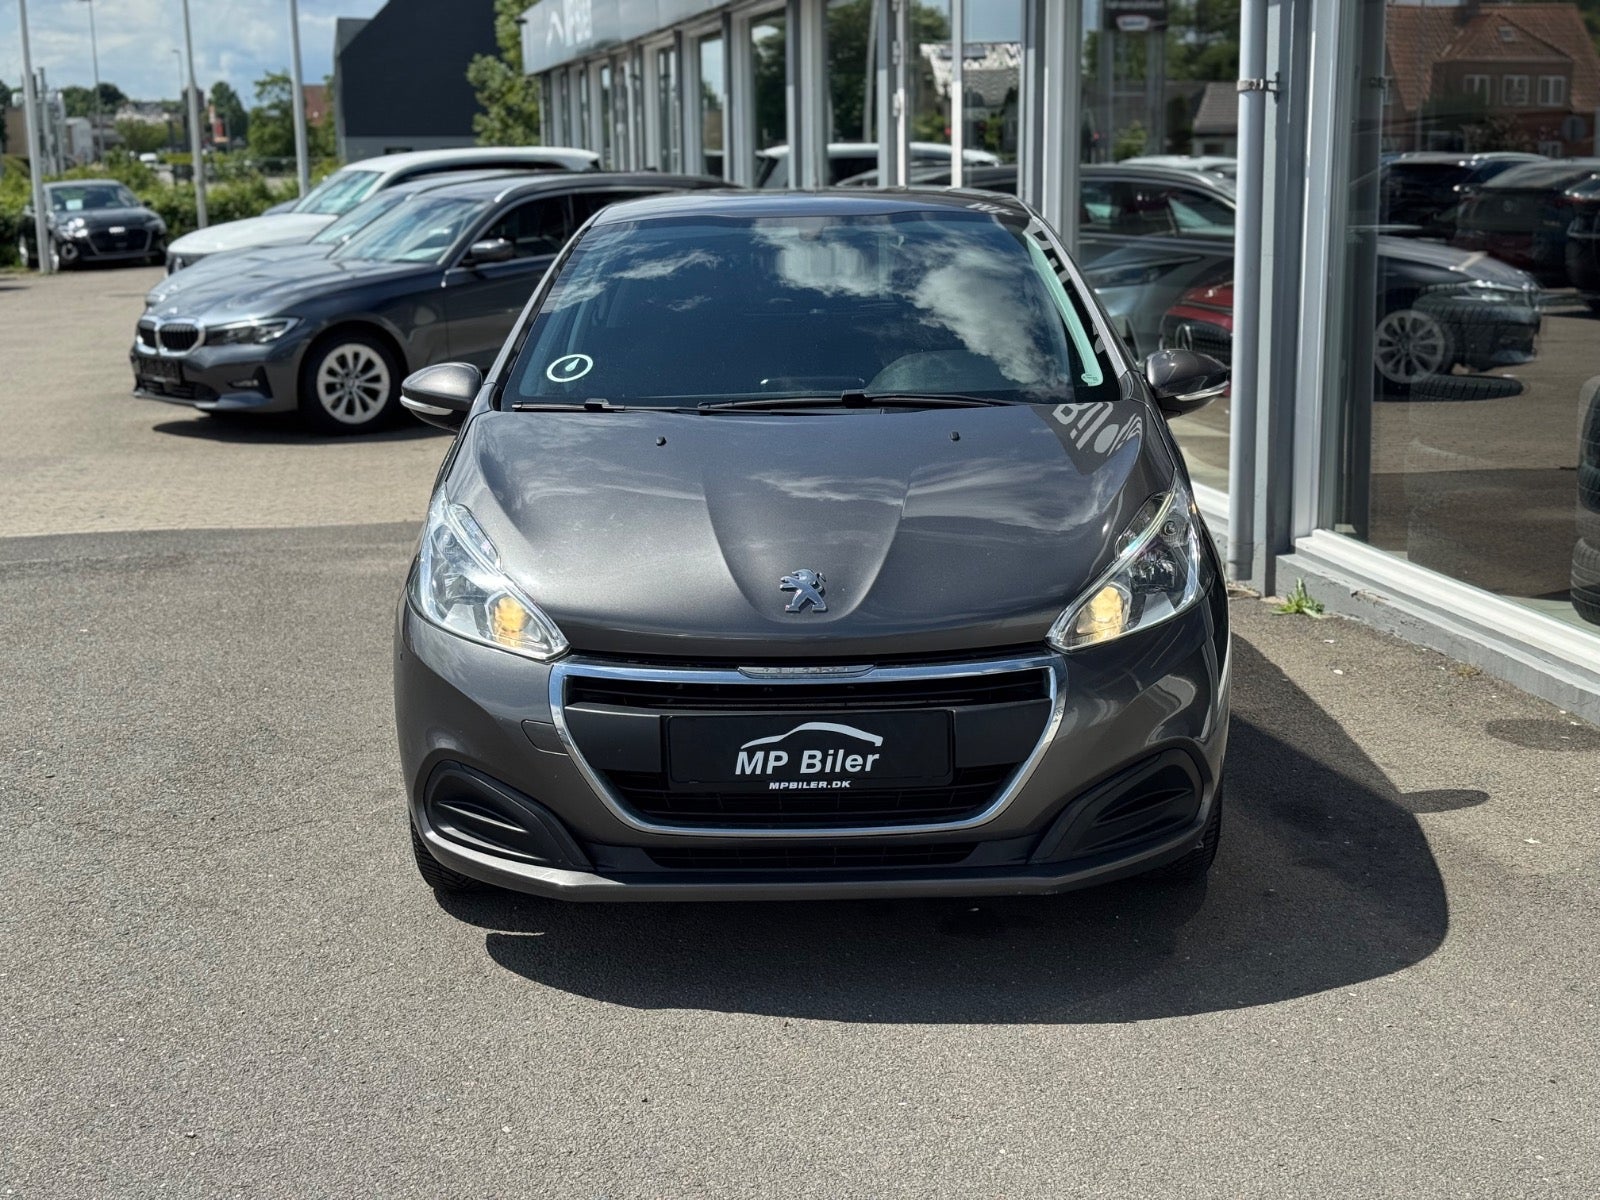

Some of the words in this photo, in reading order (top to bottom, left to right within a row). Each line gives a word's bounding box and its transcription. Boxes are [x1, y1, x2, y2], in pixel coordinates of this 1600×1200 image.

[735, 750, 788, 775] MP
[799, 749, 879, 774] Biler
[768, 780, 851, 790] MPBILER.DK
